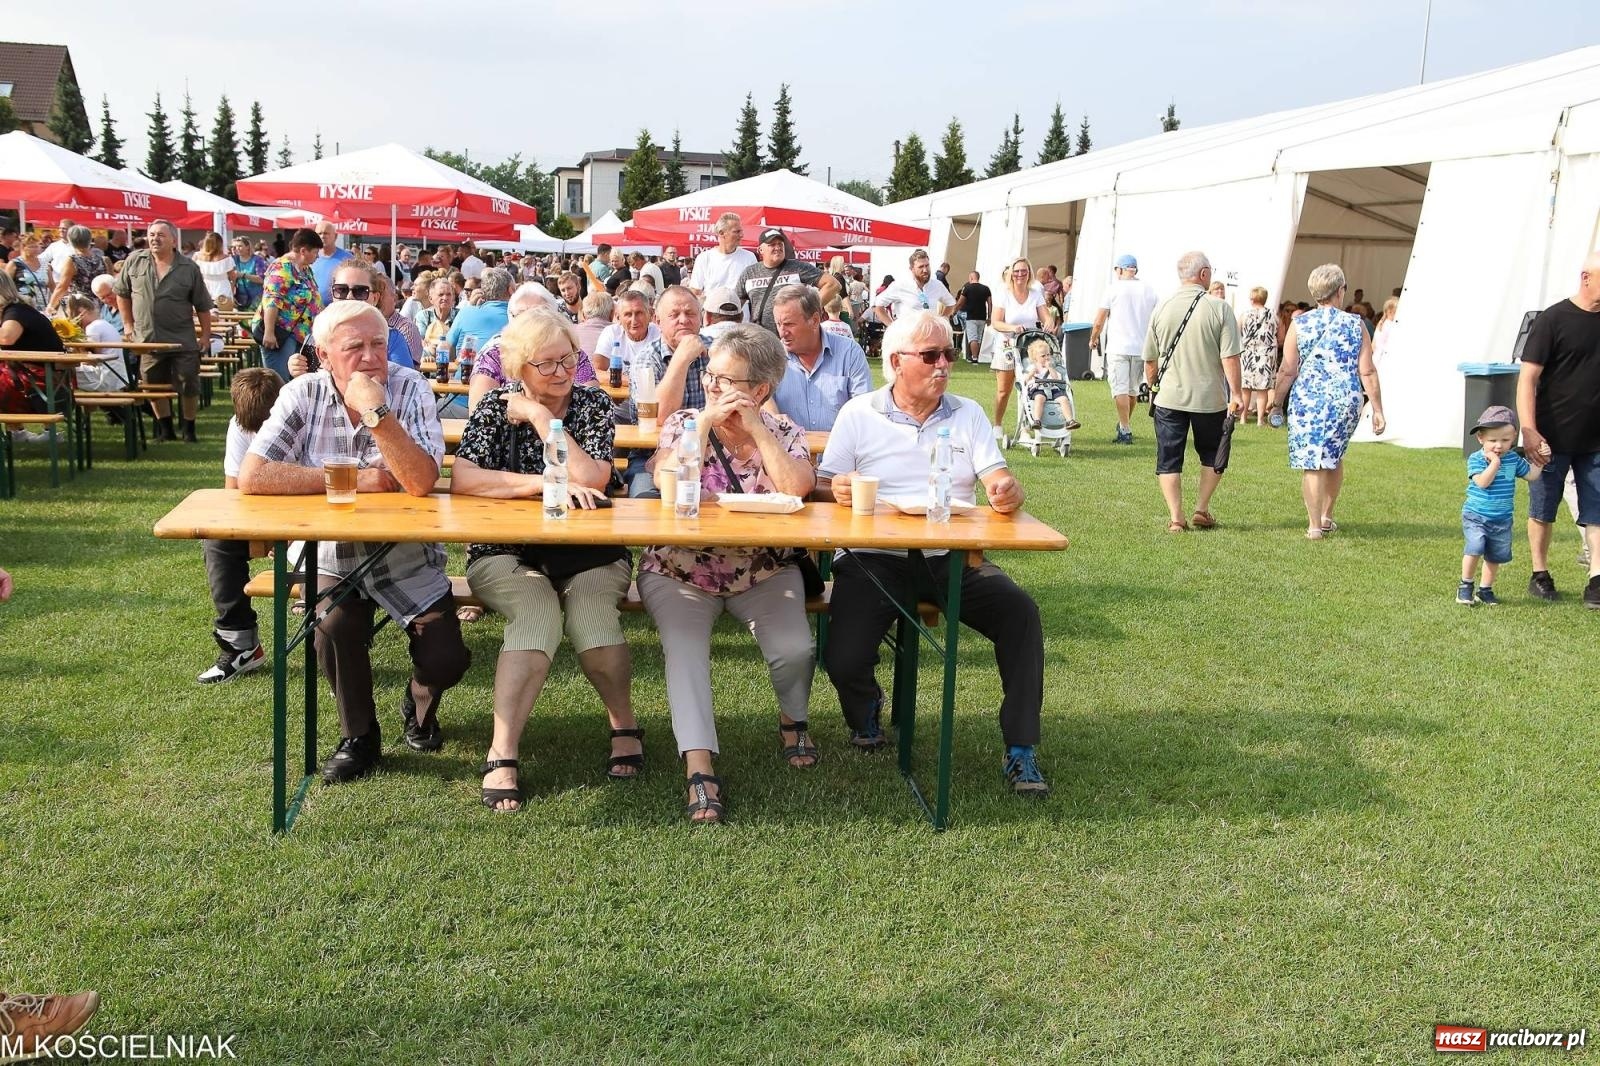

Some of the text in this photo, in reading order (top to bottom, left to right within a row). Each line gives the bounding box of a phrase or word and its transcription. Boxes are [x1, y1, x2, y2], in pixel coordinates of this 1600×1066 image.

[317, 183, 374, 200] TYSKIE
[122, 192, 151, 209] TYSKIE
[491, 198, 510, 215] TYSKIE
[678, 207, 711, 222] TYSKIE
[421, 219, 459, 230] TYSKIE
[830, 215, 872, 233] TYSKIE
[794, 249, 821, 260] YSKIE
[1226, 271, 1239, 281] WC
